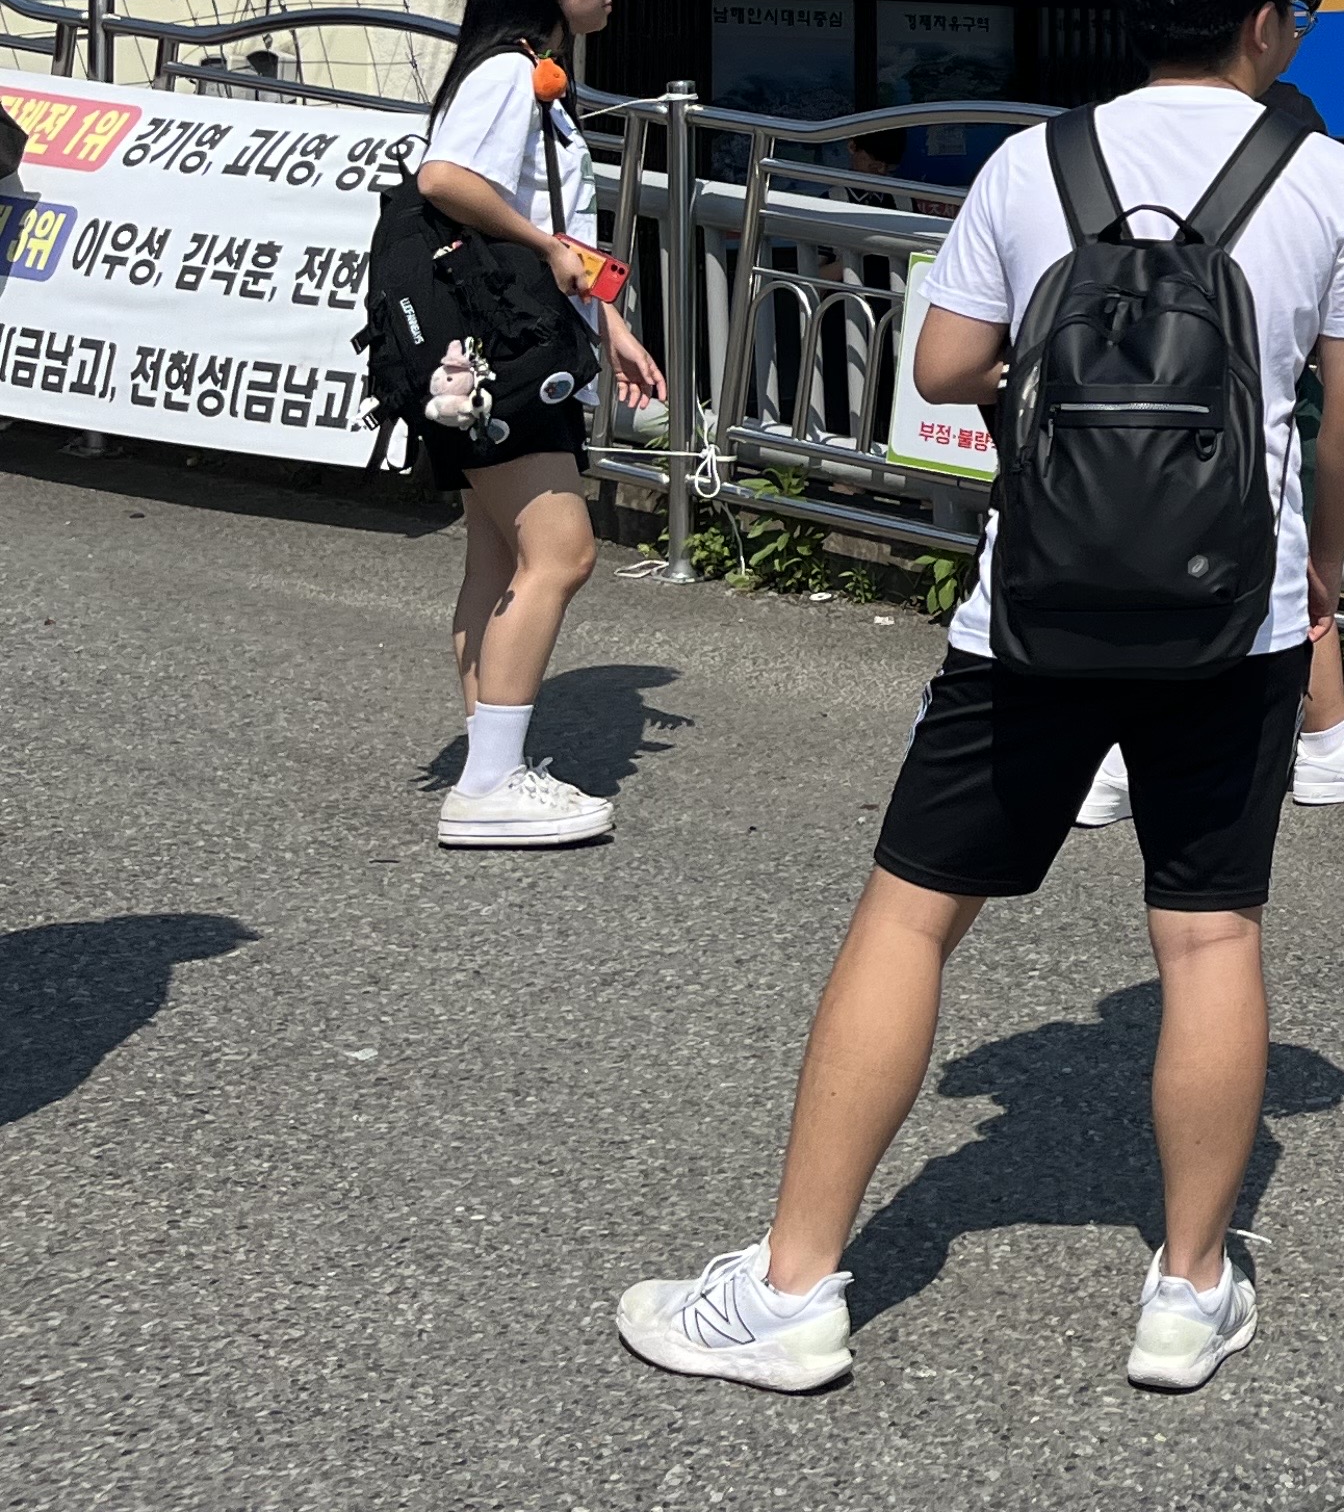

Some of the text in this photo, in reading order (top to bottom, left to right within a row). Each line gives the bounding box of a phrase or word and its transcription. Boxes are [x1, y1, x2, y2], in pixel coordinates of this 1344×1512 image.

[292, 245, 370, 310] 전현
[0, 323, 117, 402] (금남고),
[918, 421, 997, 452] 부정·불량
